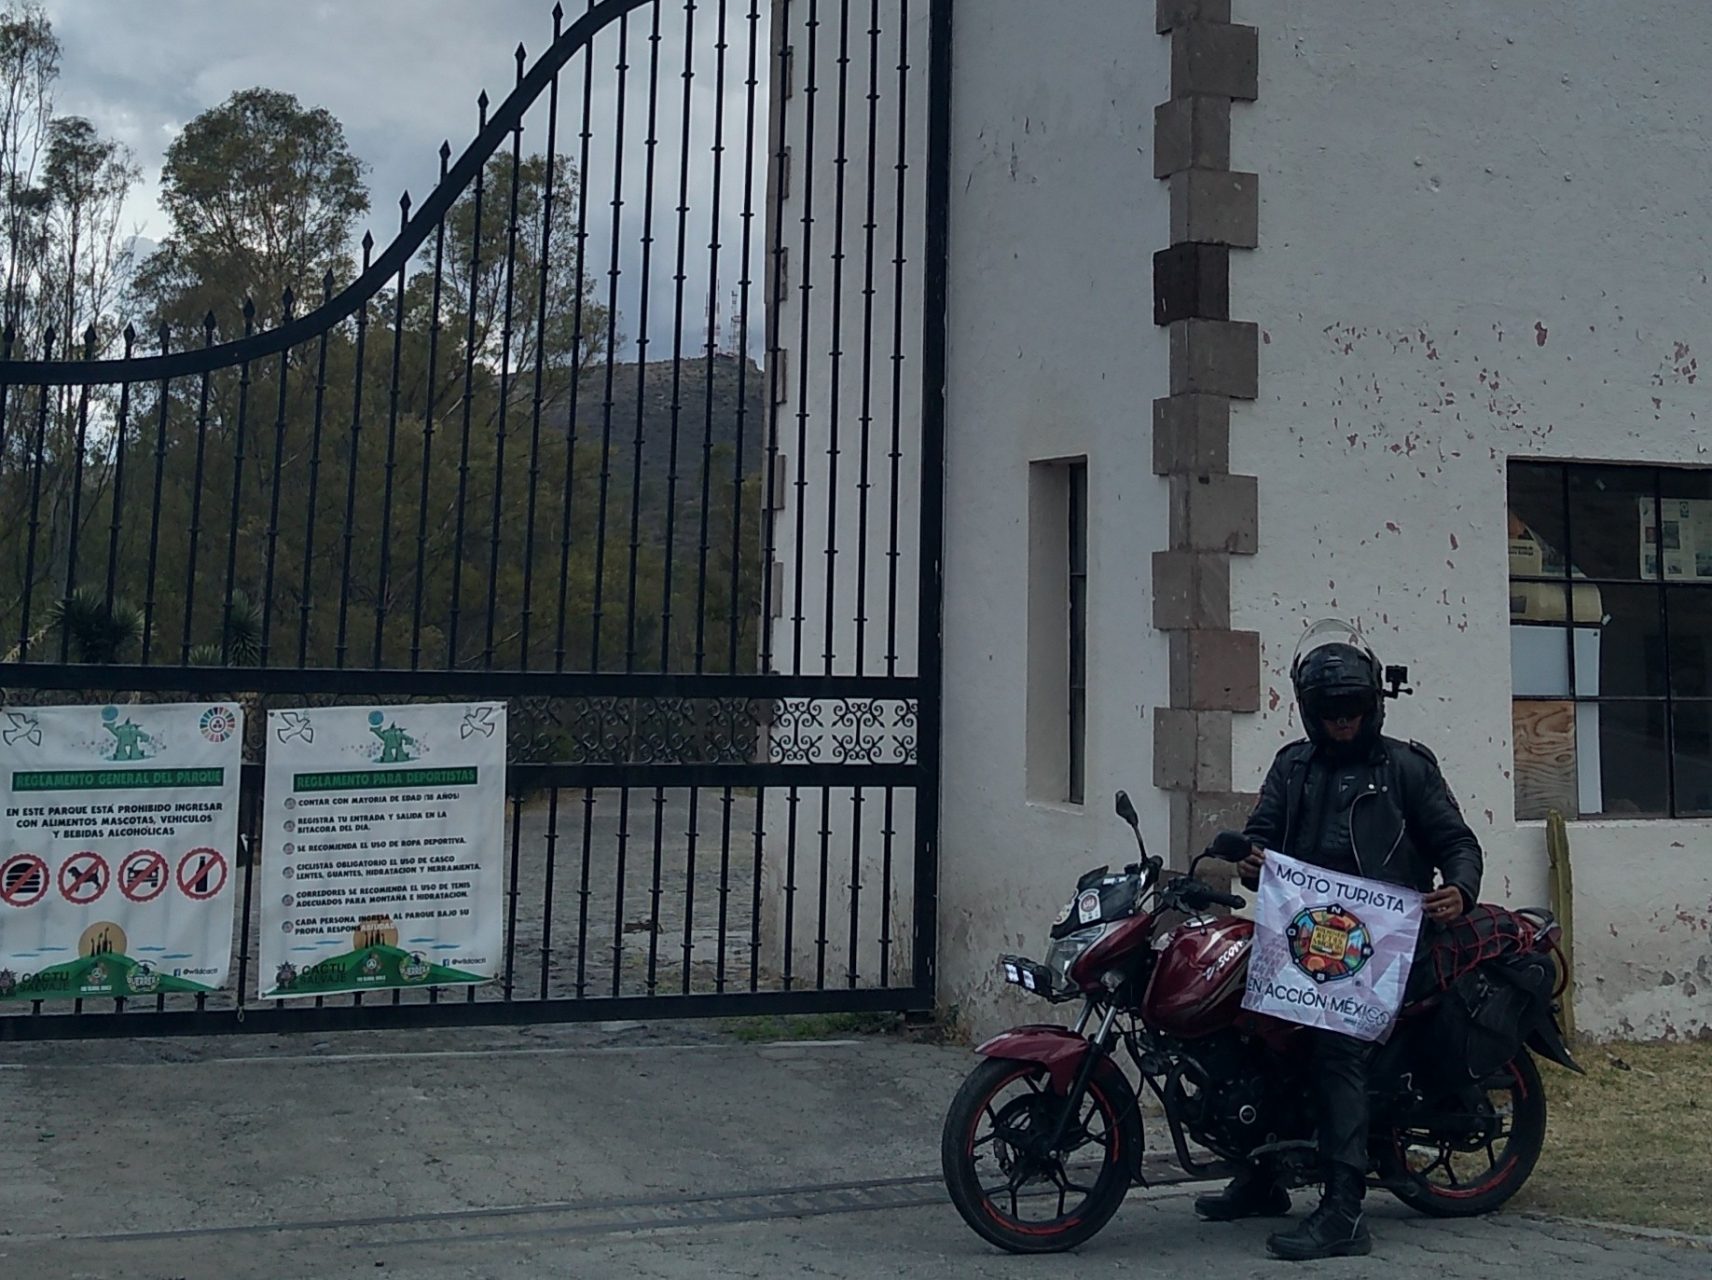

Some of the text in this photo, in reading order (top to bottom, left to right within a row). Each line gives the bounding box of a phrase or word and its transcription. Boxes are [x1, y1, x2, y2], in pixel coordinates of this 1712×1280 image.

[16, 771, 220, 787] REGLAMENTO GENERAL DEL PARQUE
[297, 770, 474, 788] REGLAMENTO PARA DEPORTISTAS
[7, 808, 19, 816] EN
[23, 808, 45, 816] ESTE
[48, 807, 87, 815] PARQUE
[118, 804, 171, 813] PROHIBIDO
[175, 803, 223, 812] INGRESAR
[17, 819, 37, 828] CON
[42, 818, 97, 827] ALIMENTOS
[64, 829, 104, 838] BEBIDAS
[309, 842, 357, 851] RECOMIENDA
[297, 862, 333, 871] CICLISTAS
[336, 859, 387, 868] OBLIGATORIO
[430, 855, 455, 863] CASCO
[296, 889, 345, 898] CORREDORES
[360, 886, 407, 894] RECOMIENDA
[1276, 864, 1405, 914] MOTO TURISTA
[296, 899, 342, 907] ADECUADOS
[405, 911, 435, 919] PARQUE
[1332, 906, 1342, 914] N
[295, 927, 324, 935] PROPIA
[302, 963, 346, 975] CACTU
[22, 972, 70, 982] CACTU
[1265, 983, 1327, 1008] ACCIÓN
[1330, 997, 1390, 1026] MÉXICO
